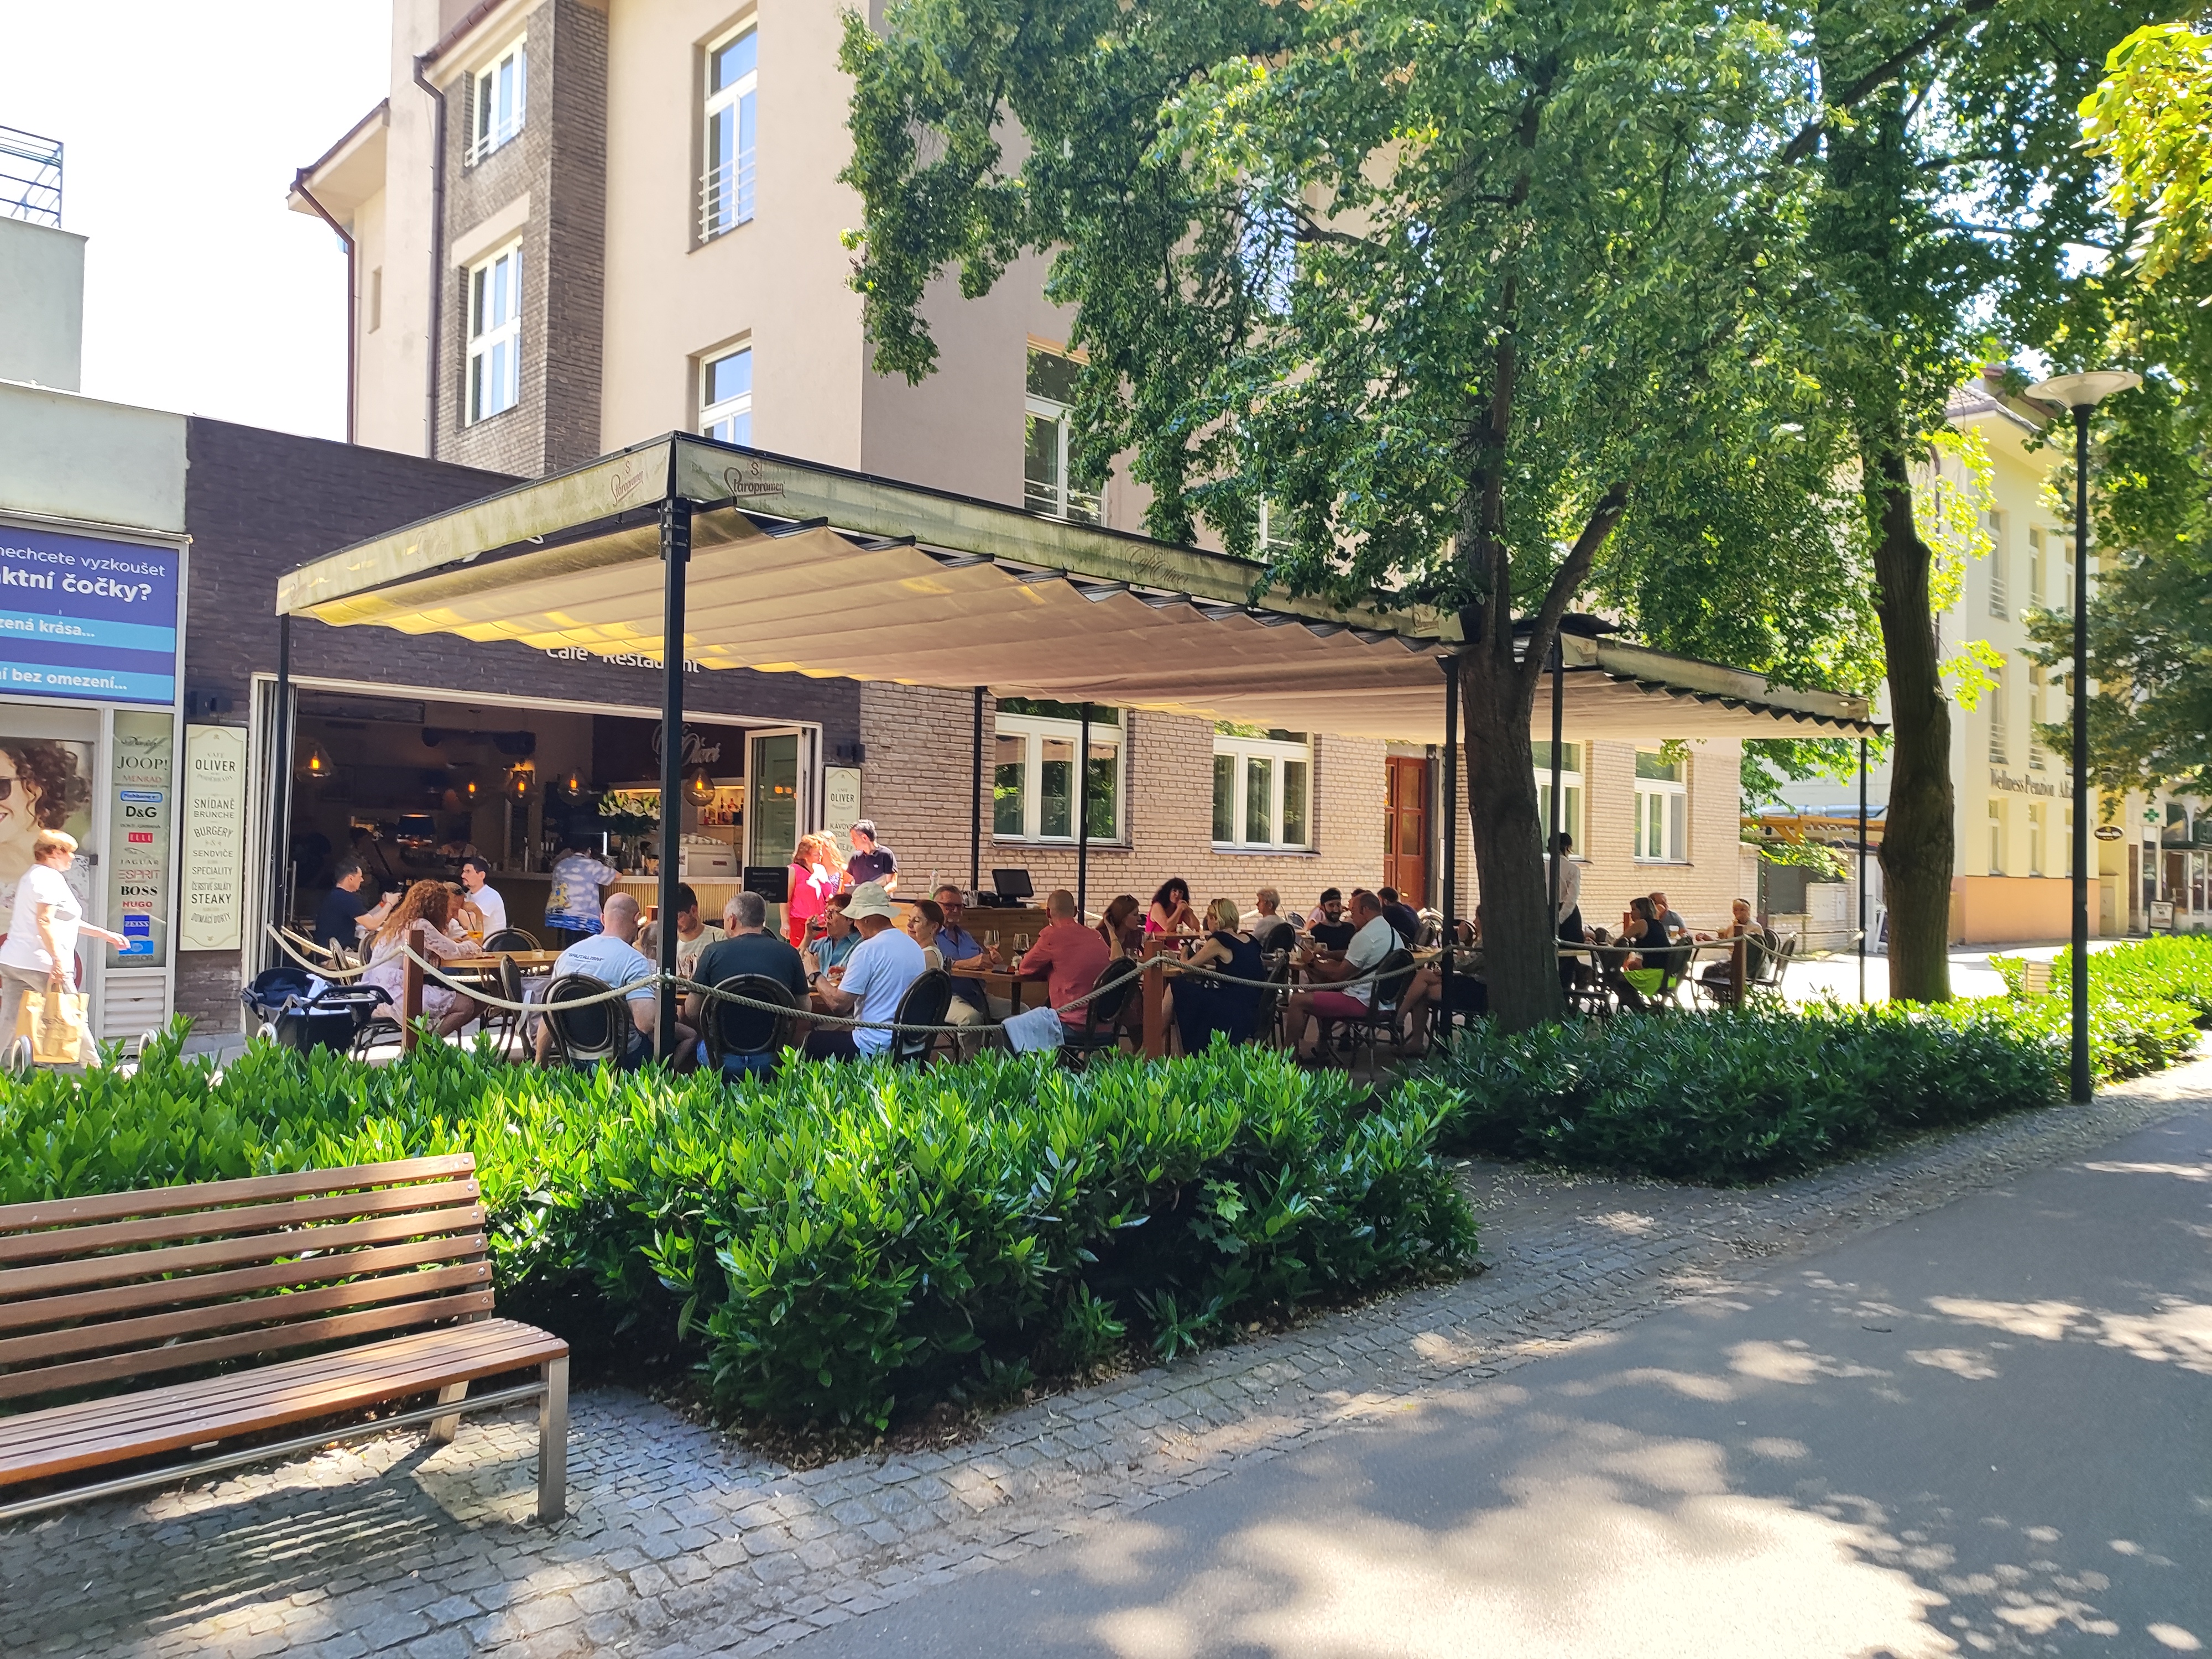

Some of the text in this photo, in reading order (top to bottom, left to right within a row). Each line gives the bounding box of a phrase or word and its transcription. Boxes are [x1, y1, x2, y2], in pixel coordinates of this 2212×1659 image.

[723, 467, 786, 498] Staropramen
[80, 556, 166, 577] vyzkoušet
[0, 566, 152, 602] ktní čočky?
[39, 619, 95, 637] krása...
[12, 668, 42, 684] bez
[46, 676, 127, 690] omezení...
[116, 756, 168, 770] JOOP!
[195, 759, 236, 772] OLIVER
[123, 774, 162, 783] MENRAD
[1990, 768, 2025, 793] Wellness
[2025, 774, 2056, 798] Penzion
[194, 796, 235, 810] SNÍDANĚ
[831, 793, 855, 803] OLIVER
[126, 805, 157, 817] D&G
[193, 826, 233, 838] BURGERY
[192, 849, 233, 857] SENDVIČE
[118, 869, 161, 879] ESPRIT
[192, 867, 232, 875] SPECIALITY
[121, 885, 158, 896] BOSS
[191, 893, 232, 904] STEAKY
